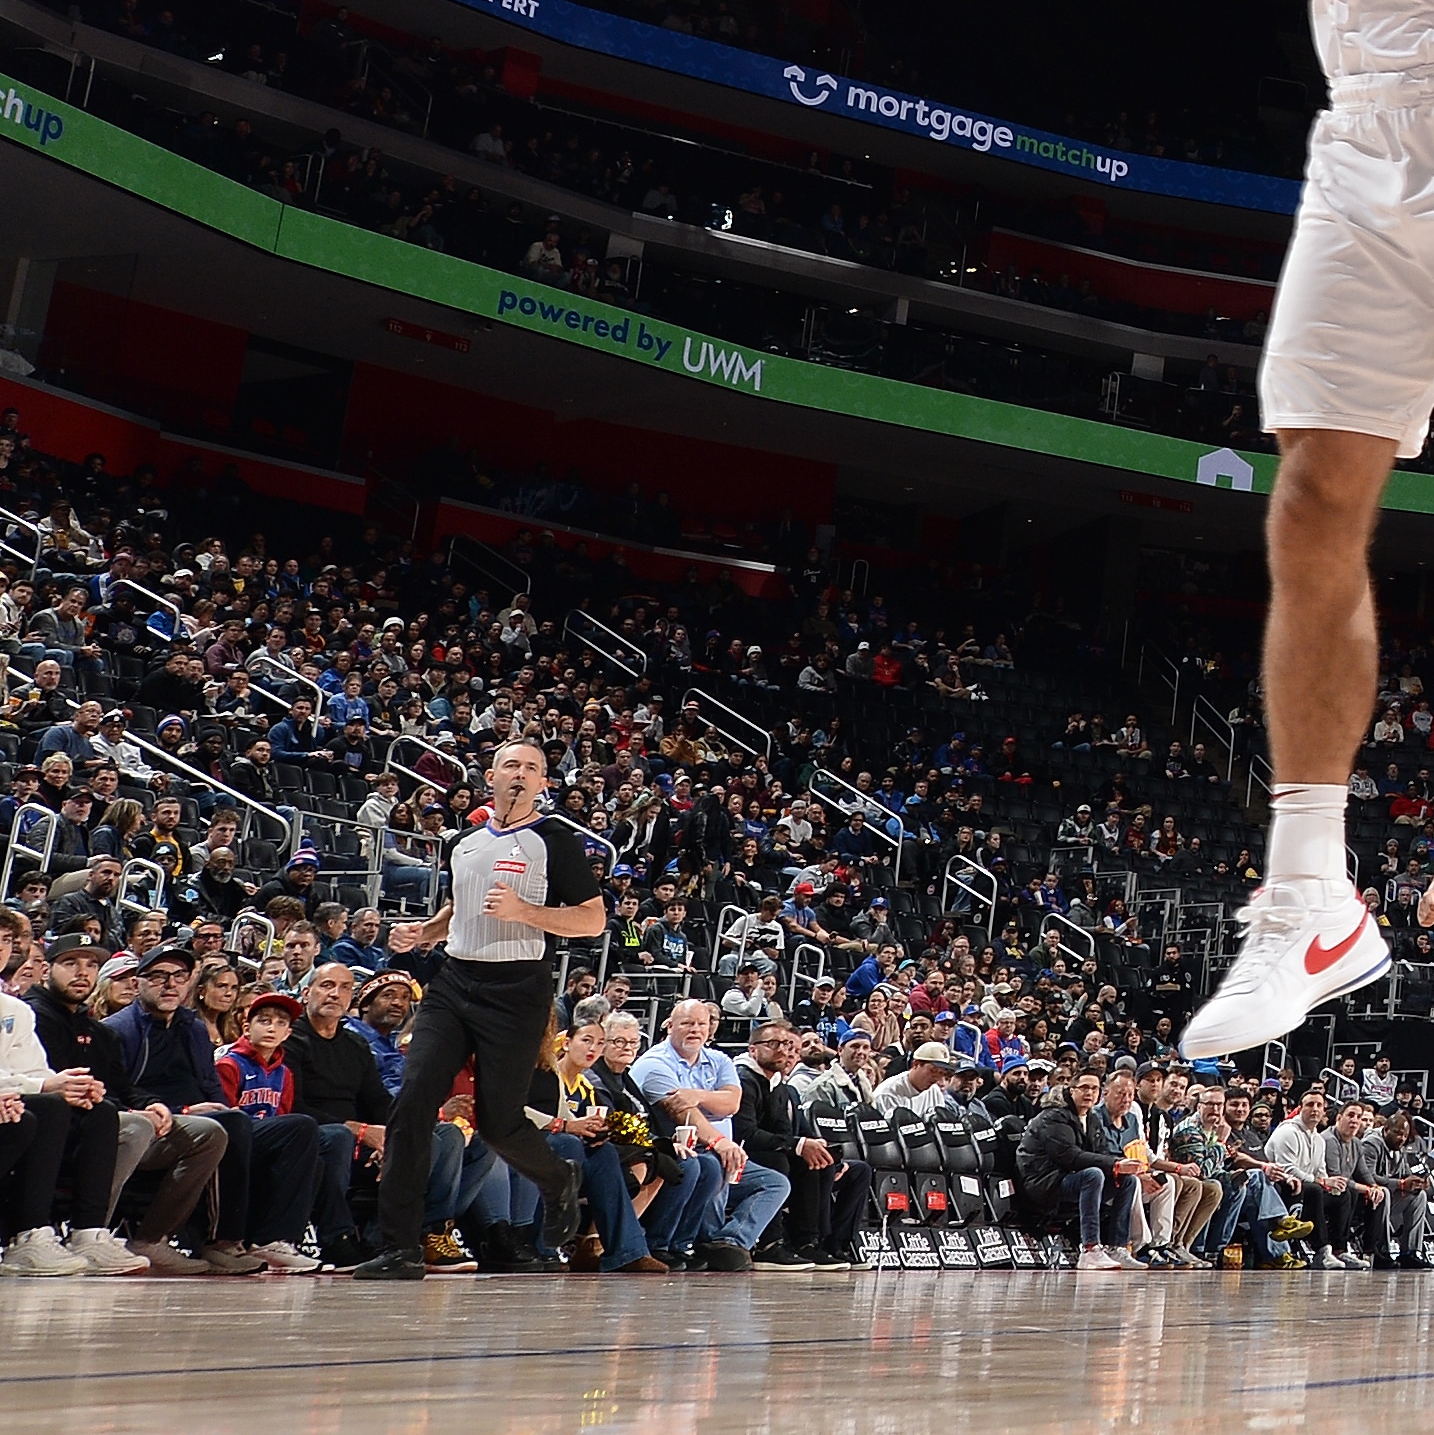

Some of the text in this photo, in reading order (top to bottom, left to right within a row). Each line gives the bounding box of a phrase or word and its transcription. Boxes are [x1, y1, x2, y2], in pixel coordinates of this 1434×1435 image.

[498, 287, 764, 393] powered by UWM
[975, 1227, 1002, 1246] Little
